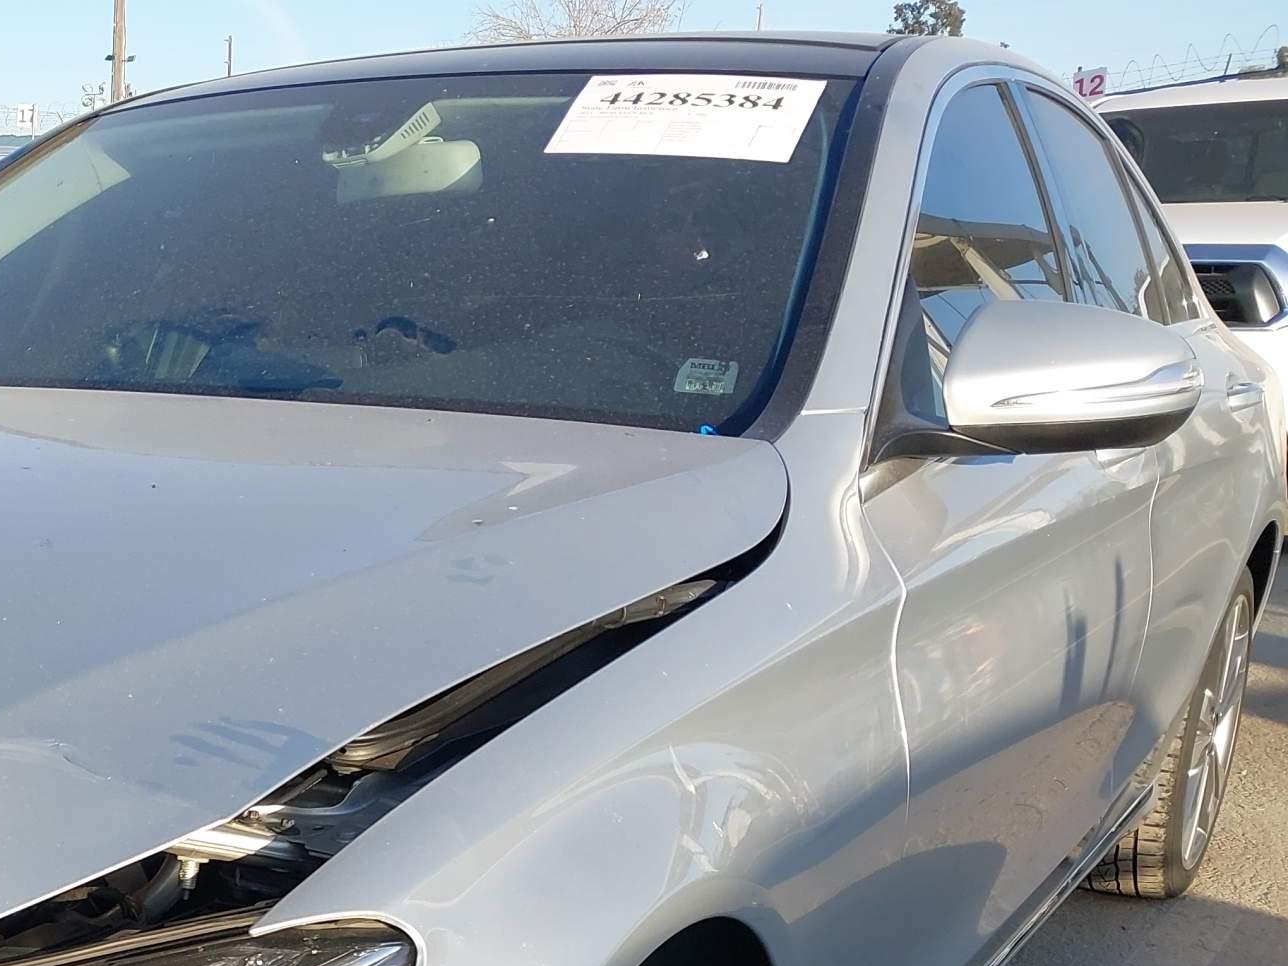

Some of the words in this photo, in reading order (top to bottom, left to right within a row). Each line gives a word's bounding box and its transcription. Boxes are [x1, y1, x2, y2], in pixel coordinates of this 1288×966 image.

[1074, 75, 1104, 97] 12
[600, 91, 786, 110] 44285384
[18, 109, 34, 122] 17
